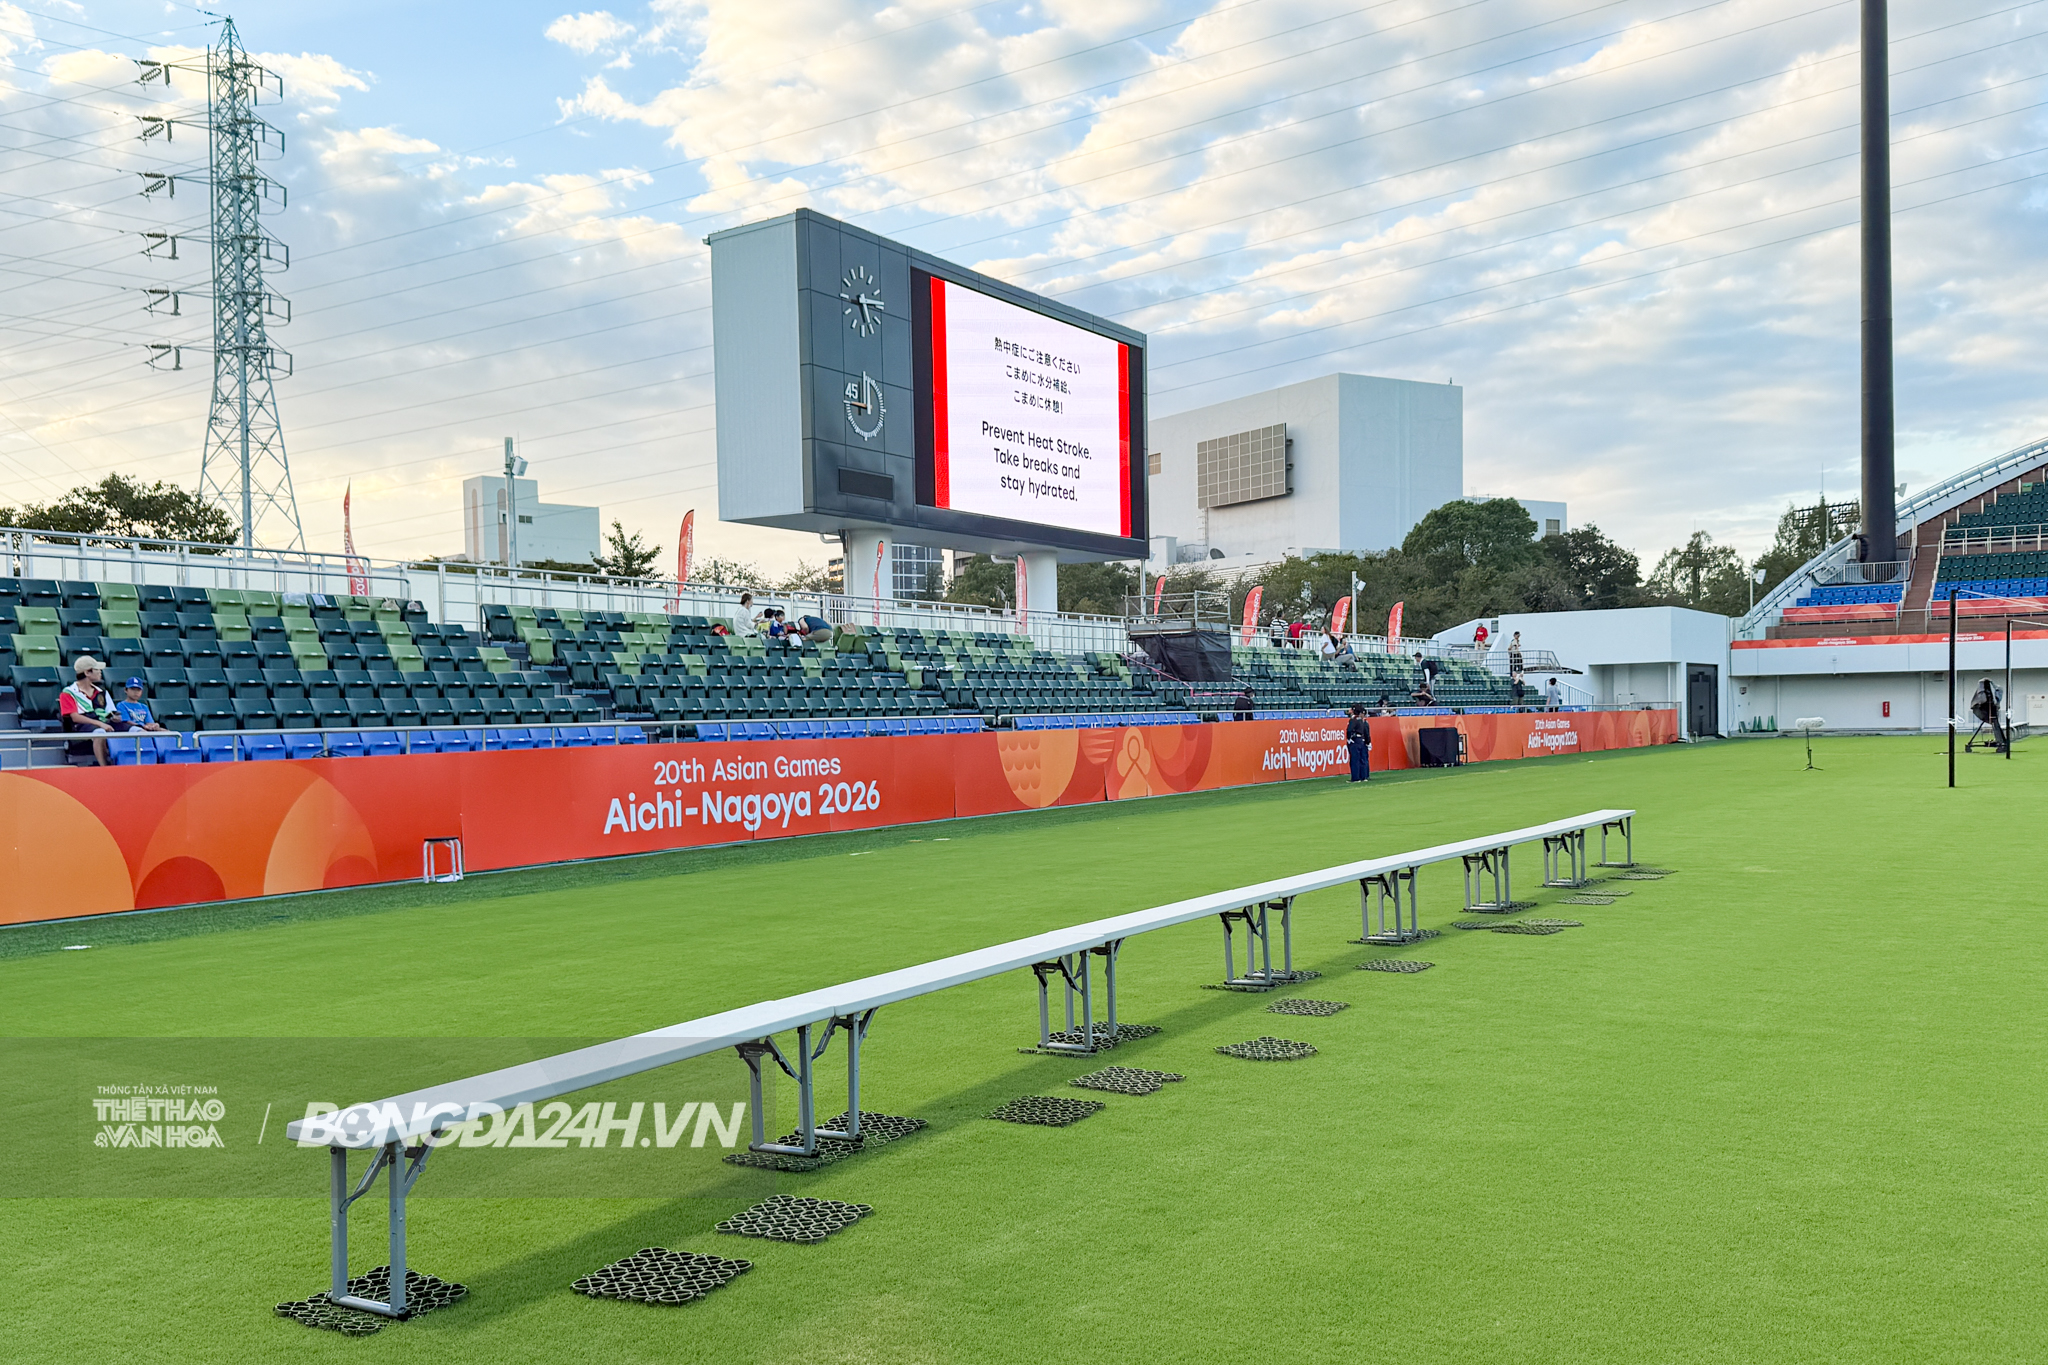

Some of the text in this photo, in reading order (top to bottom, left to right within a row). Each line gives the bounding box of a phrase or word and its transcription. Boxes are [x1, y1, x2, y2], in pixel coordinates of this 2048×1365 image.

[994, 336, 1081, 375] 熱中症にご注意ください
[845, 382, 859, 399] 45
[982, 420, 1092, 460] Prevent Heat Stroke.
[993, 447, 1081, 480] Take breaks and
[1000, 474, 1078, 502] stay hydrated.
[1280, 727, 1345, 743] 20th Asian Games
[1535, 718, 1570, 730] 20th Asian Games
[1528, 731, 1577, 751] Aichi-Nagoya 2026
[654, 755, 841, 785] 20th Asian Games
[1262, 745, 1349, 773] Aichi-Nagoya 20
[603, 780, 881, 834] Aichi-Nagoya 2026
